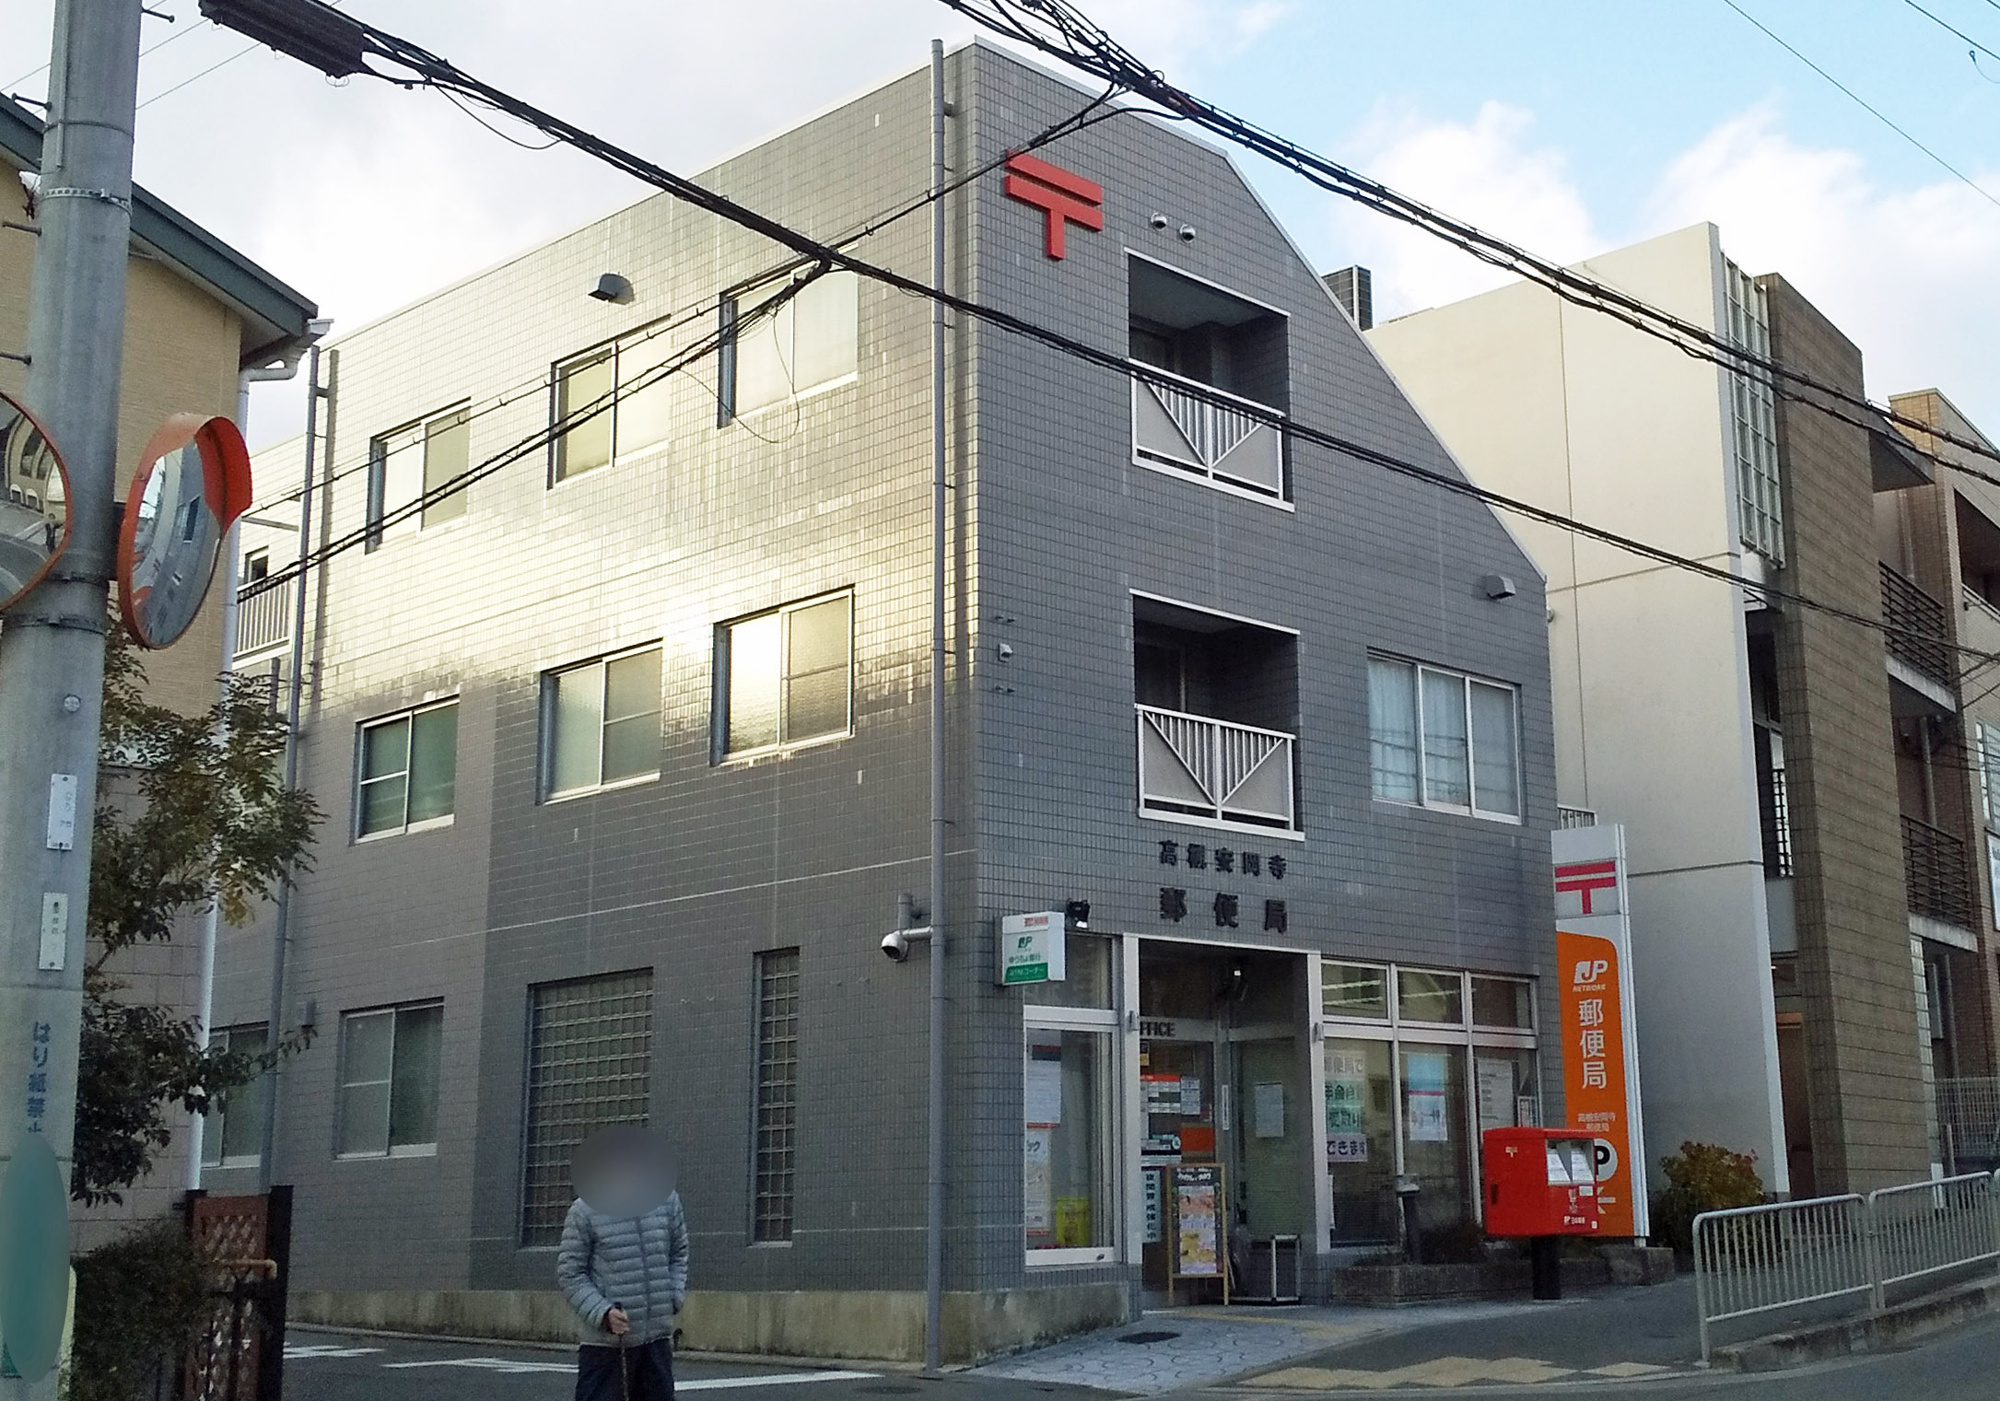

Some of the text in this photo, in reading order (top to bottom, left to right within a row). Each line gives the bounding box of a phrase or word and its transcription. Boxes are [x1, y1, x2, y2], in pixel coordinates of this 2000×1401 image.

[1159, 887, 1288, 934] 郵便局
[1573, 960, 1609, 984] JP
[1572, 984, 1606, 993] NETWORK
[1578, 998, 1608, 1090] 郵便局
[1326, 1140, 1366, 1156] できます
